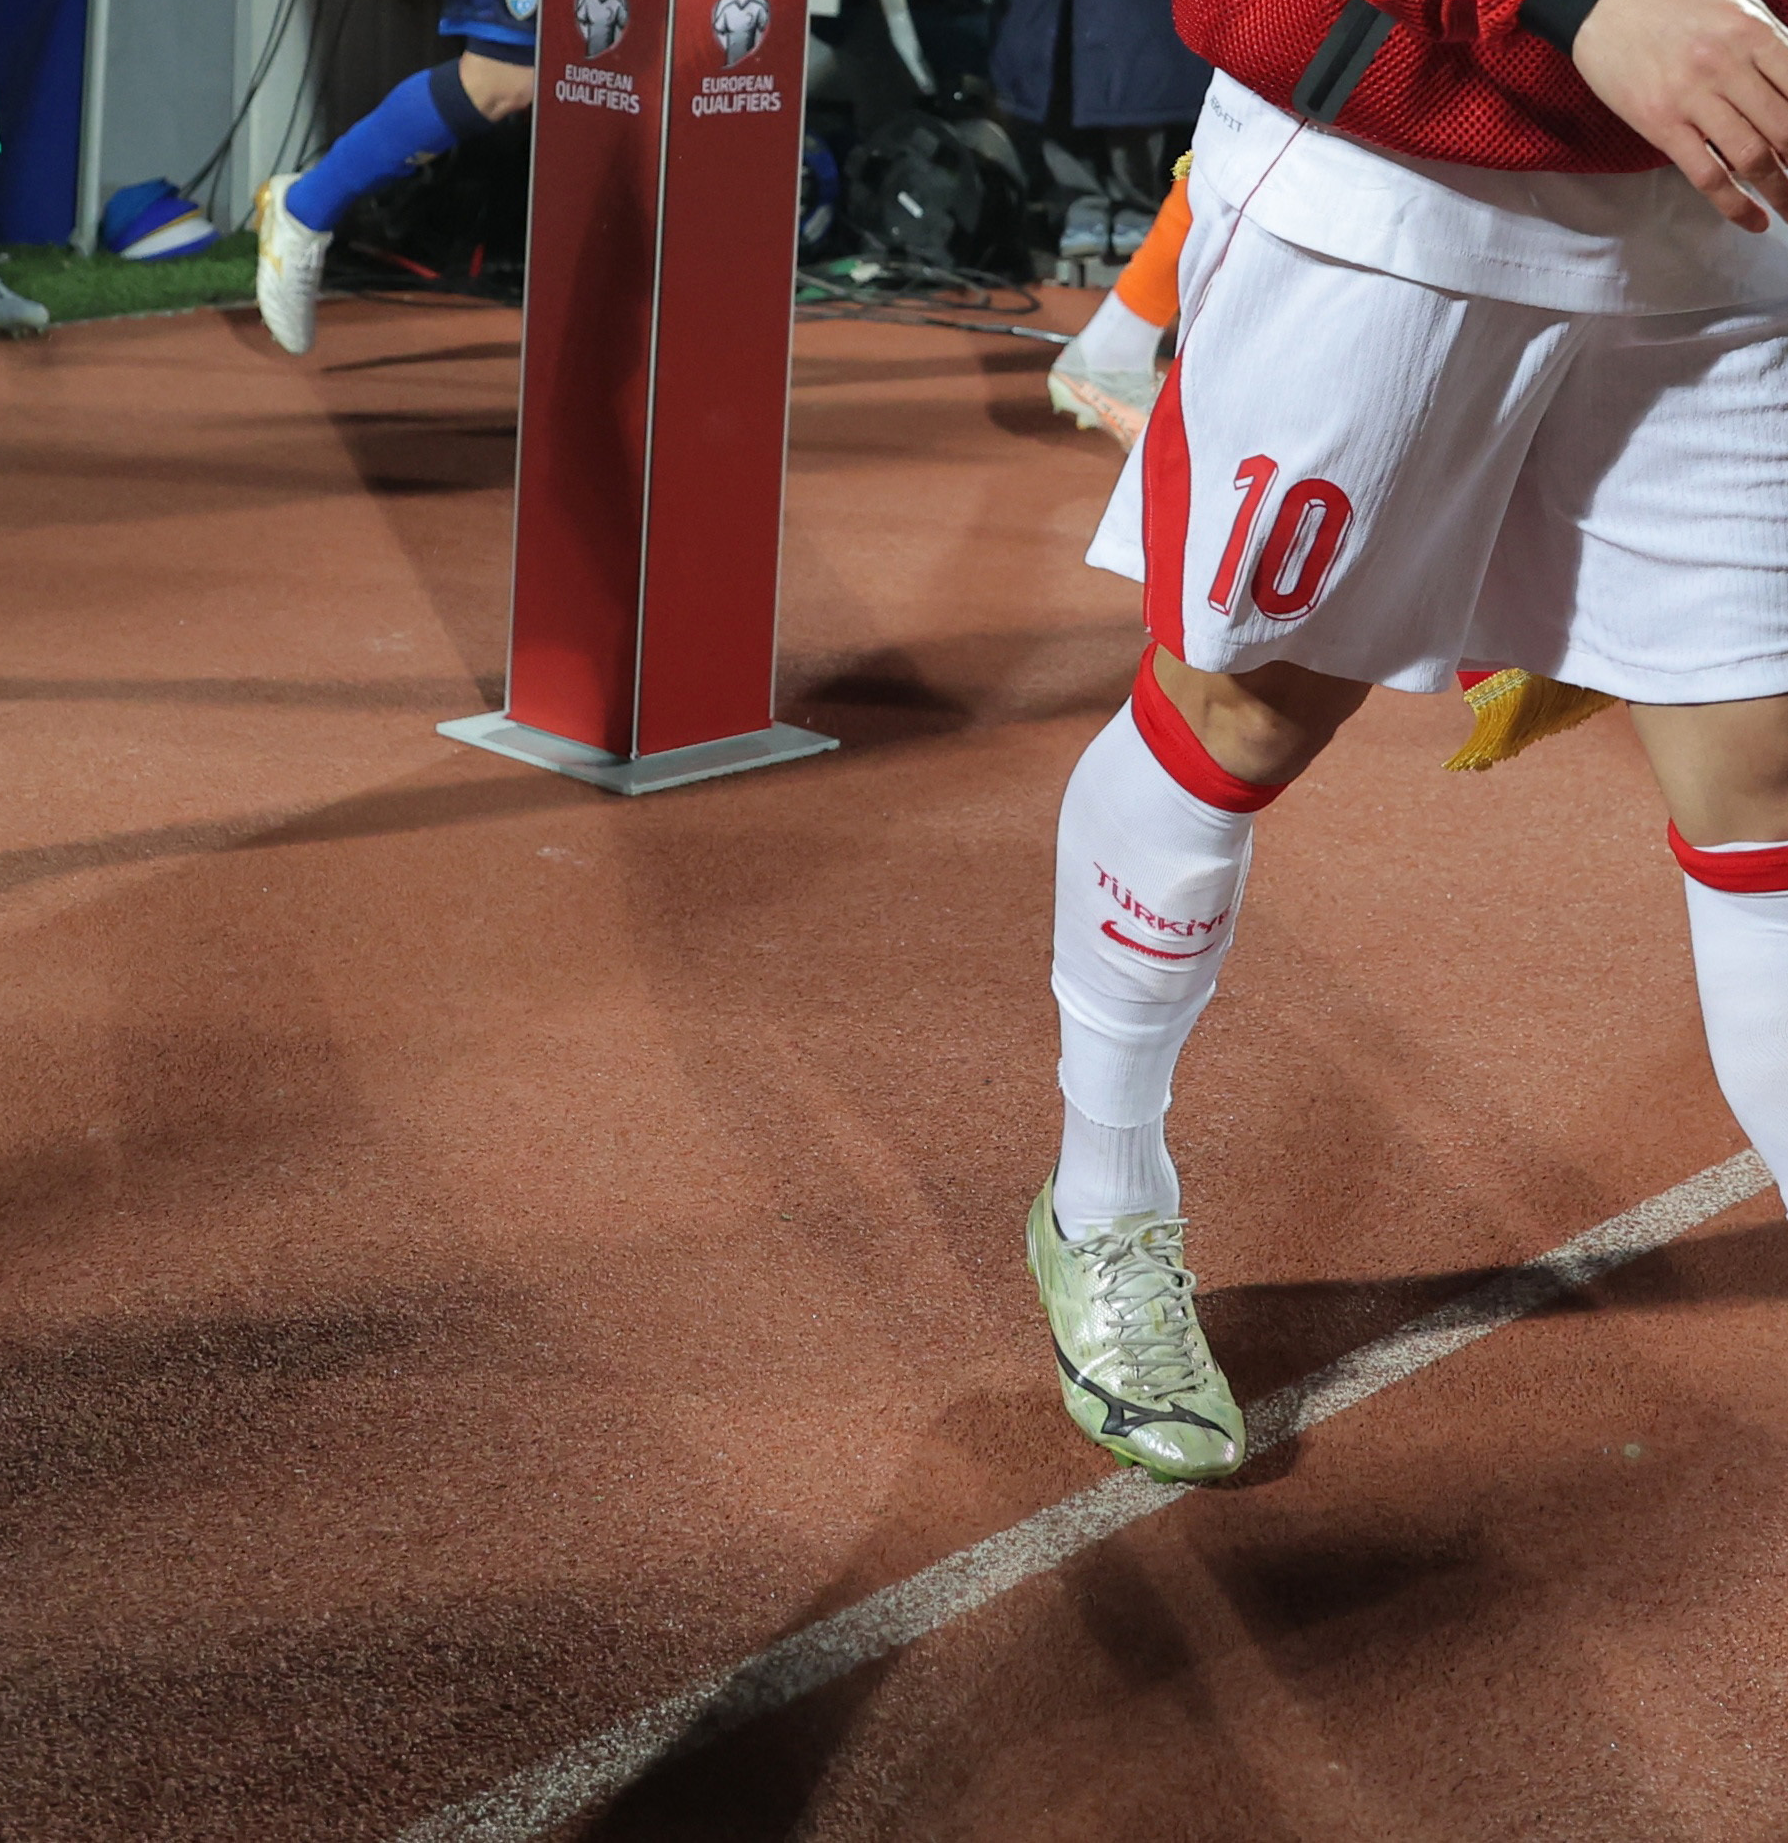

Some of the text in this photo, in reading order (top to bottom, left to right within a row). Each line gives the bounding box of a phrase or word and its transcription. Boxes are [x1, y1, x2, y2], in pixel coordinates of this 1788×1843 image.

[565, 63, 634, 92] EUROPEAN
[702, 74, 774, 94] EUROPEAN
[555, 79, 641, 115] QUALIFIERS
[691, 91, 782, 117] QUALIFIERS
[1207, 454, 1353, 621] 10
